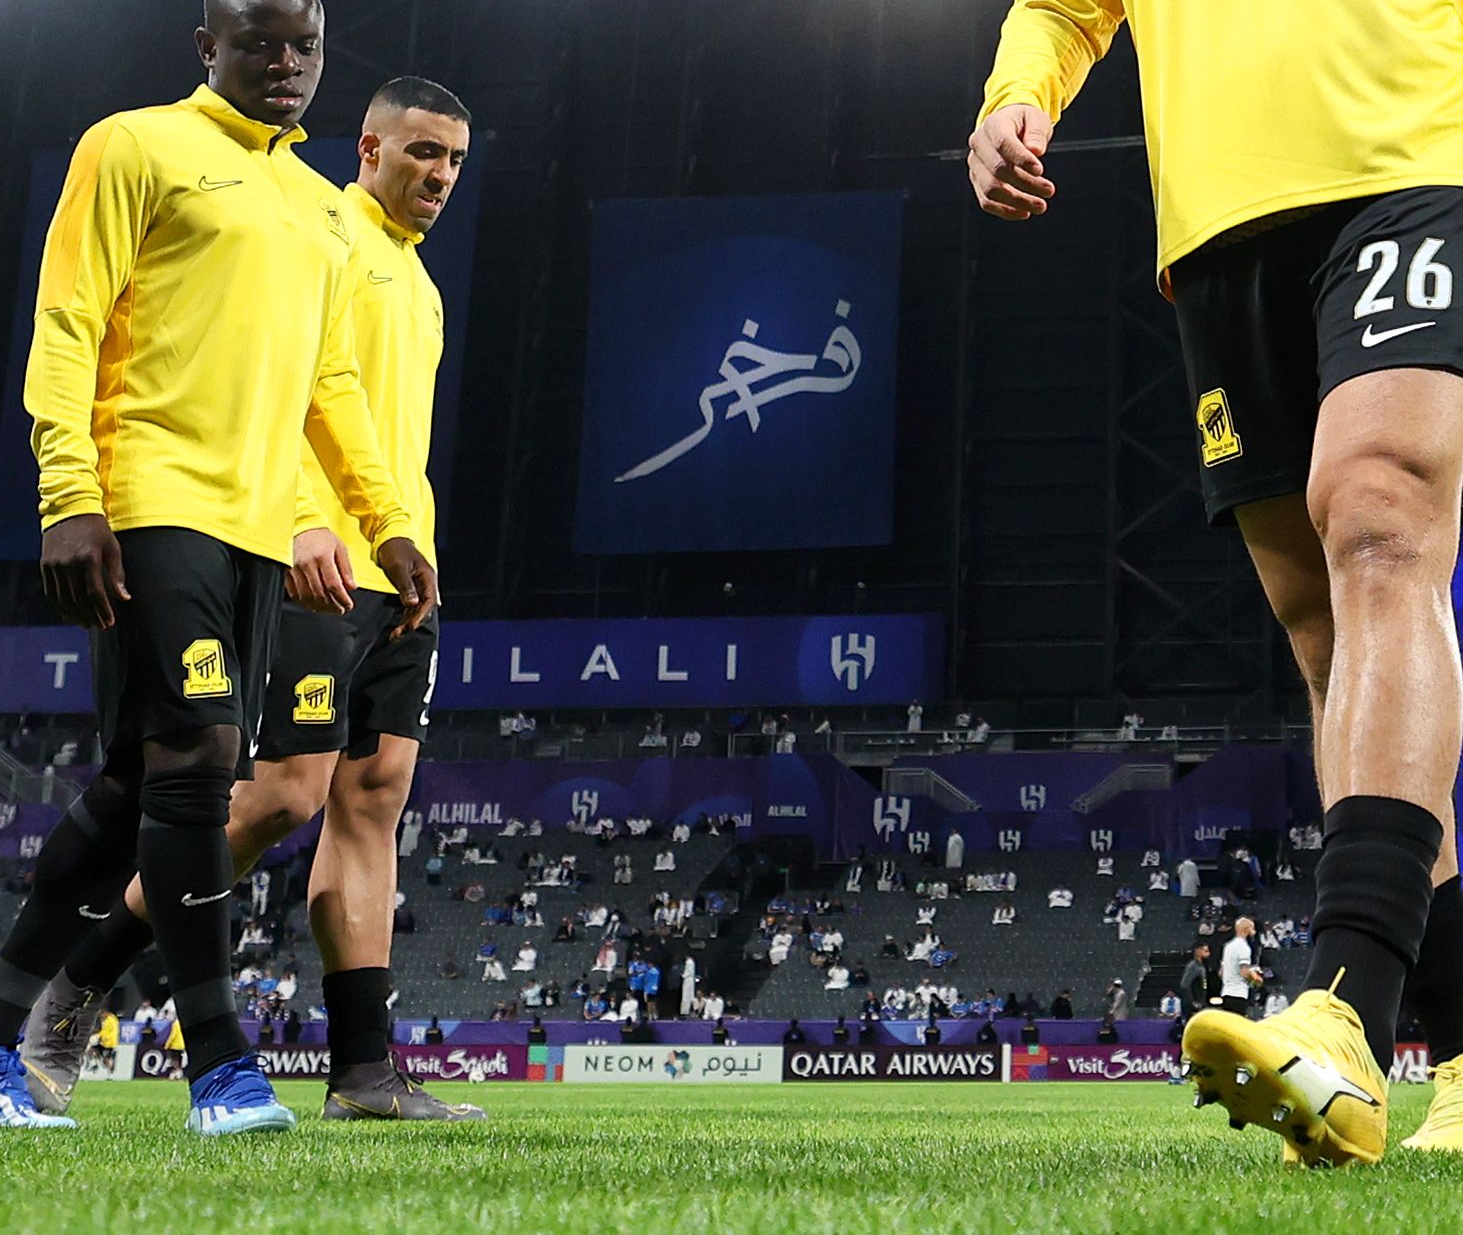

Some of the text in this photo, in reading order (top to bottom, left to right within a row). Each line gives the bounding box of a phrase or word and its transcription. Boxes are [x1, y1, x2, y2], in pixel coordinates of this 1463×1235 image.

[1353, 237, 1453, 320] 26
[613, 298, 862, 483] فخر
[44, 652, 79, 689] T
[461, 643, 738, 684] ILALI
[427, 803, 504, 825] ALHILAL
[767, 805, 807, 818] ALHILAL
[257, 1049, 331, 1074] RWAYS
[405, 1053, 440, 1074] Visit
[584, 1054, 653, 1073] NEOM
[702, 1052, 763, 1077] نيوم
[790, 1051, 995, 1076] QATAR AIRWAYS
[1067, 1055, 1104, 1075] Visit
